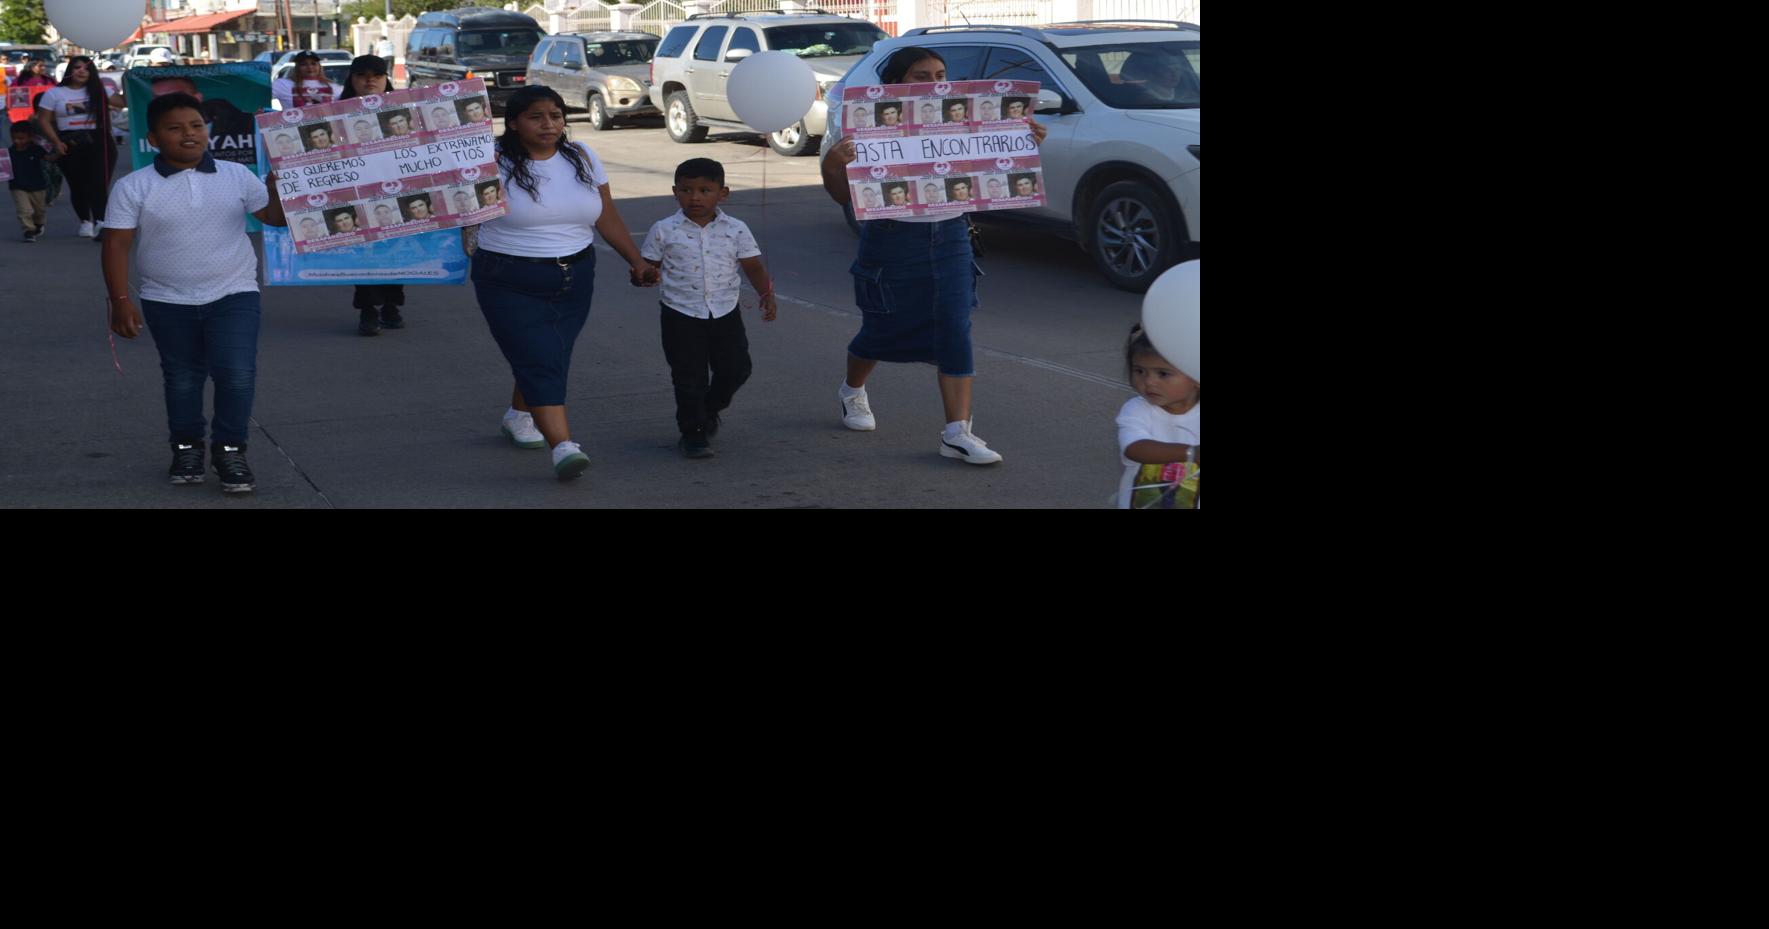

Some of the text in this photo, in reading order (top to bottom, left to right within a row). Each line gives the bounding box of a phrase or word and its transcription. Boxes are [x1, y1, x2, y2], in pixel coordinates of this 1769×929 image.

[208, 134, 253, 150] YAH
[855, 134, 1036, 163] ASTA ENCONTRARLOS
[394, 147, 417, 160] LOS
[398, 146, 485, 174] MUCHO TIOS
[303, 157, 366, 176] QUEREMOS
[281, 171, 359, 195] DE REGRESO
